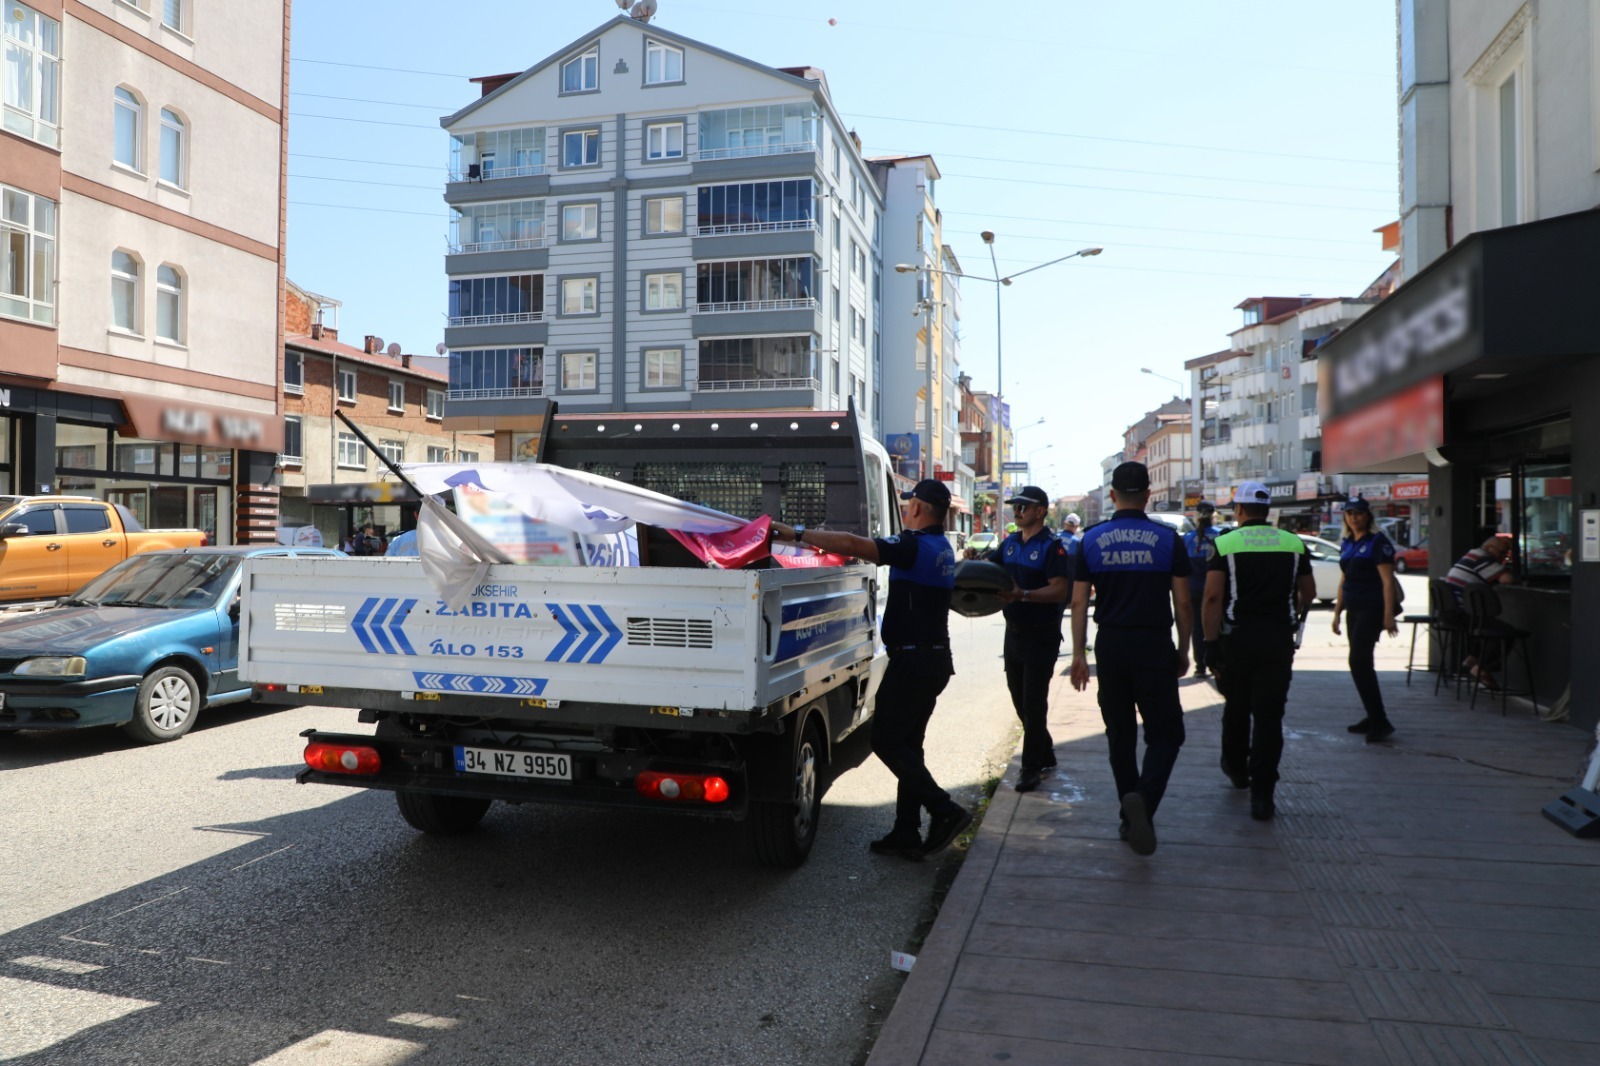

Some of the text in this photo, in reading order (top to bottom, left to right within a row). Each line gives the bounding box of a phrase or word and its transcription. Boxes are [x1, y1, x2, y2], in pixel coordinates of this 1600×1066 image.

[1101, 550, 1154, 565] ZABITA
[431, 643, 524, 658] ALO 153
[465, 750, 568, 776] 34 NZ 9950
